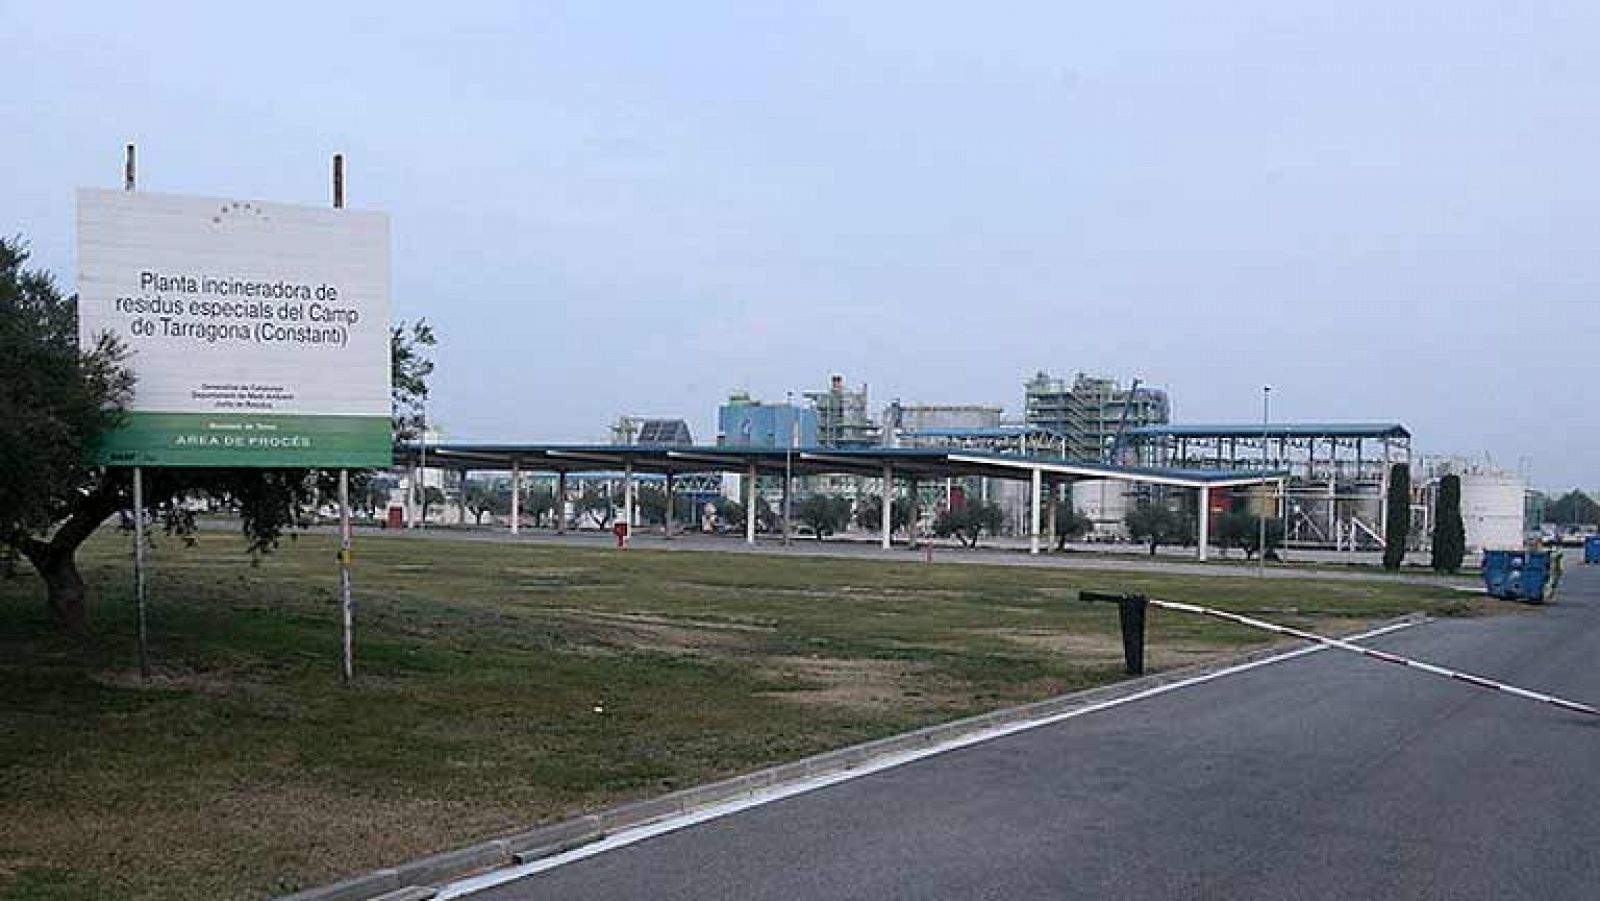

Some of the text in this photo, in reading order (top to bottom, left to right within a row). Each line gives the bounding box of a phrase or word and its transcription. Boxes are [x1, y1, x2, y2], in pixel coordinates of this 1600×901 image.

[141, 272, 337, 301] Planta incineradora de
[116, 295, 359, 326] residus especials del Camp
[131, 316, 154, 336] de
[160, 316, 251, 342] Tarragona
